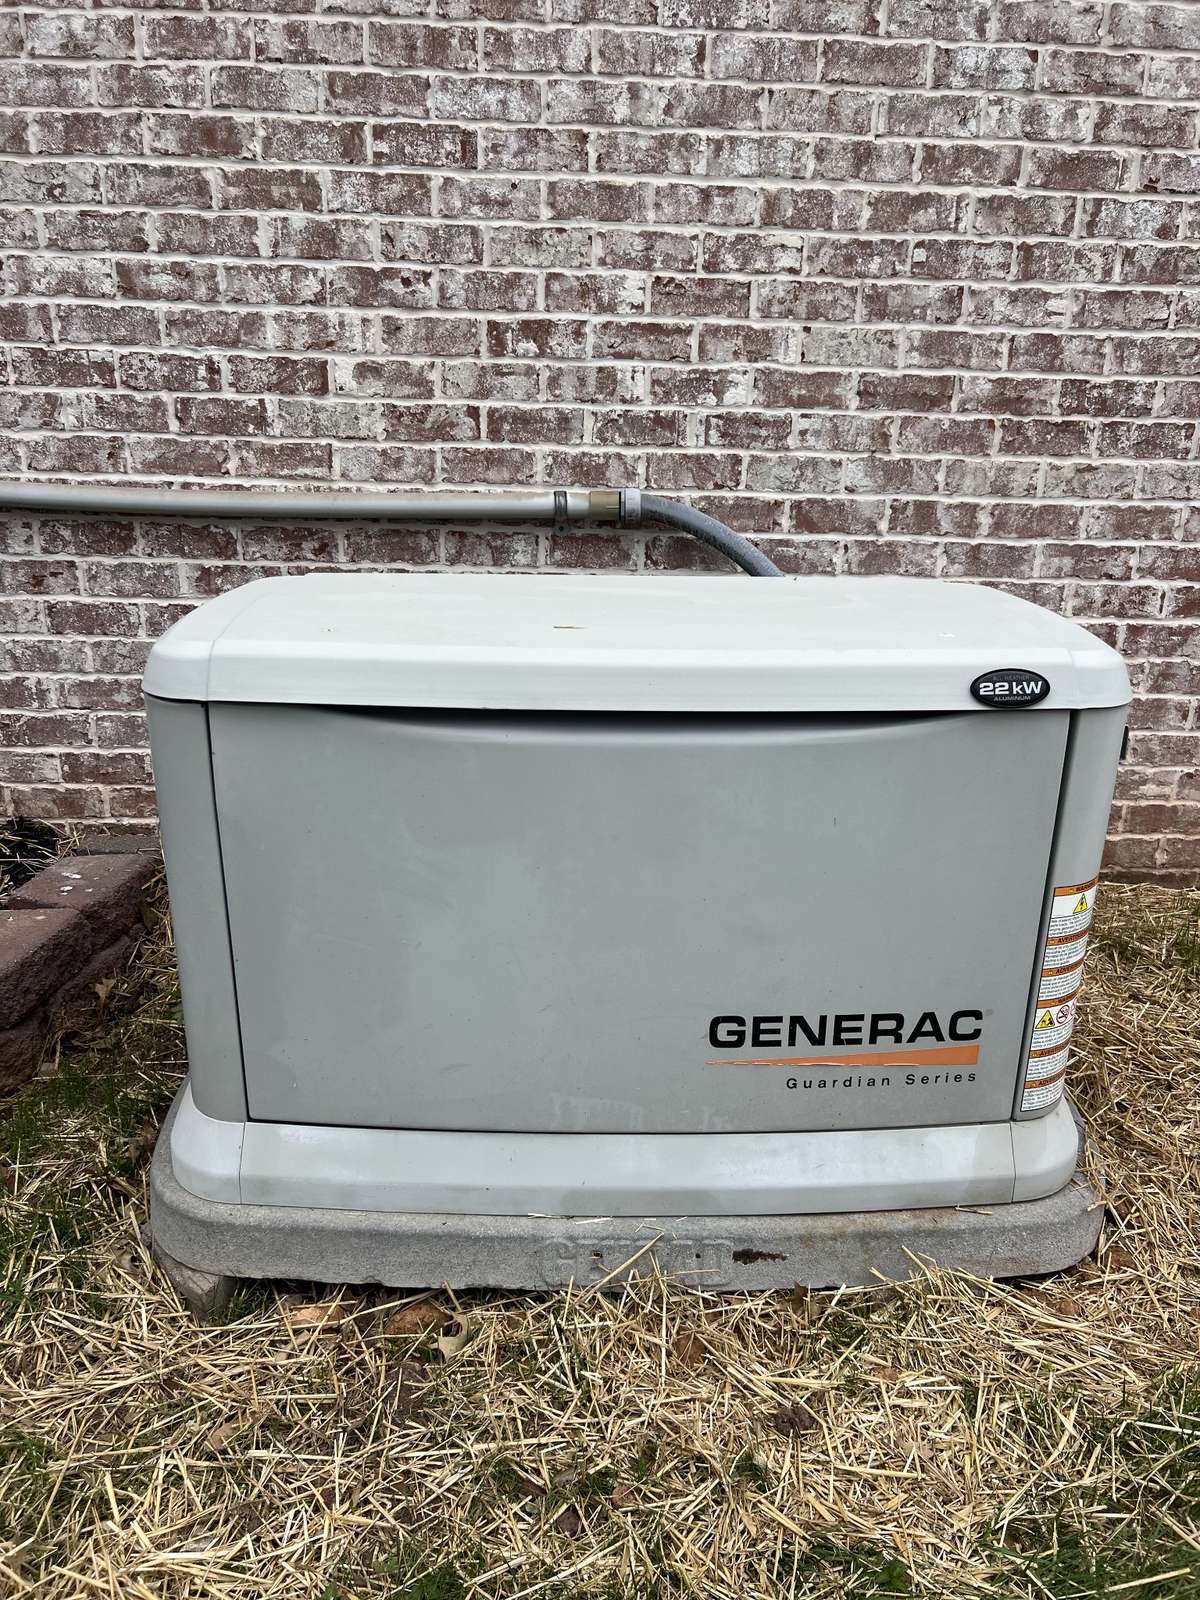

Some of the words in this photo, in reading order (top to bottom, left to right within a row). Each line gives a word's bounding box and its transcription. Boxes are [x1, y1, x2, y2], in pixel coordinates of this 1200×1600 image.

[979, 682, 1010, 695] 22
[1012, 680, 1043, 695] kW
[709, 1009, 983, 1048] GENERAC
[786, 1075, 891, 1090] Guardian
[905, 1072, 977, 1086] Series
